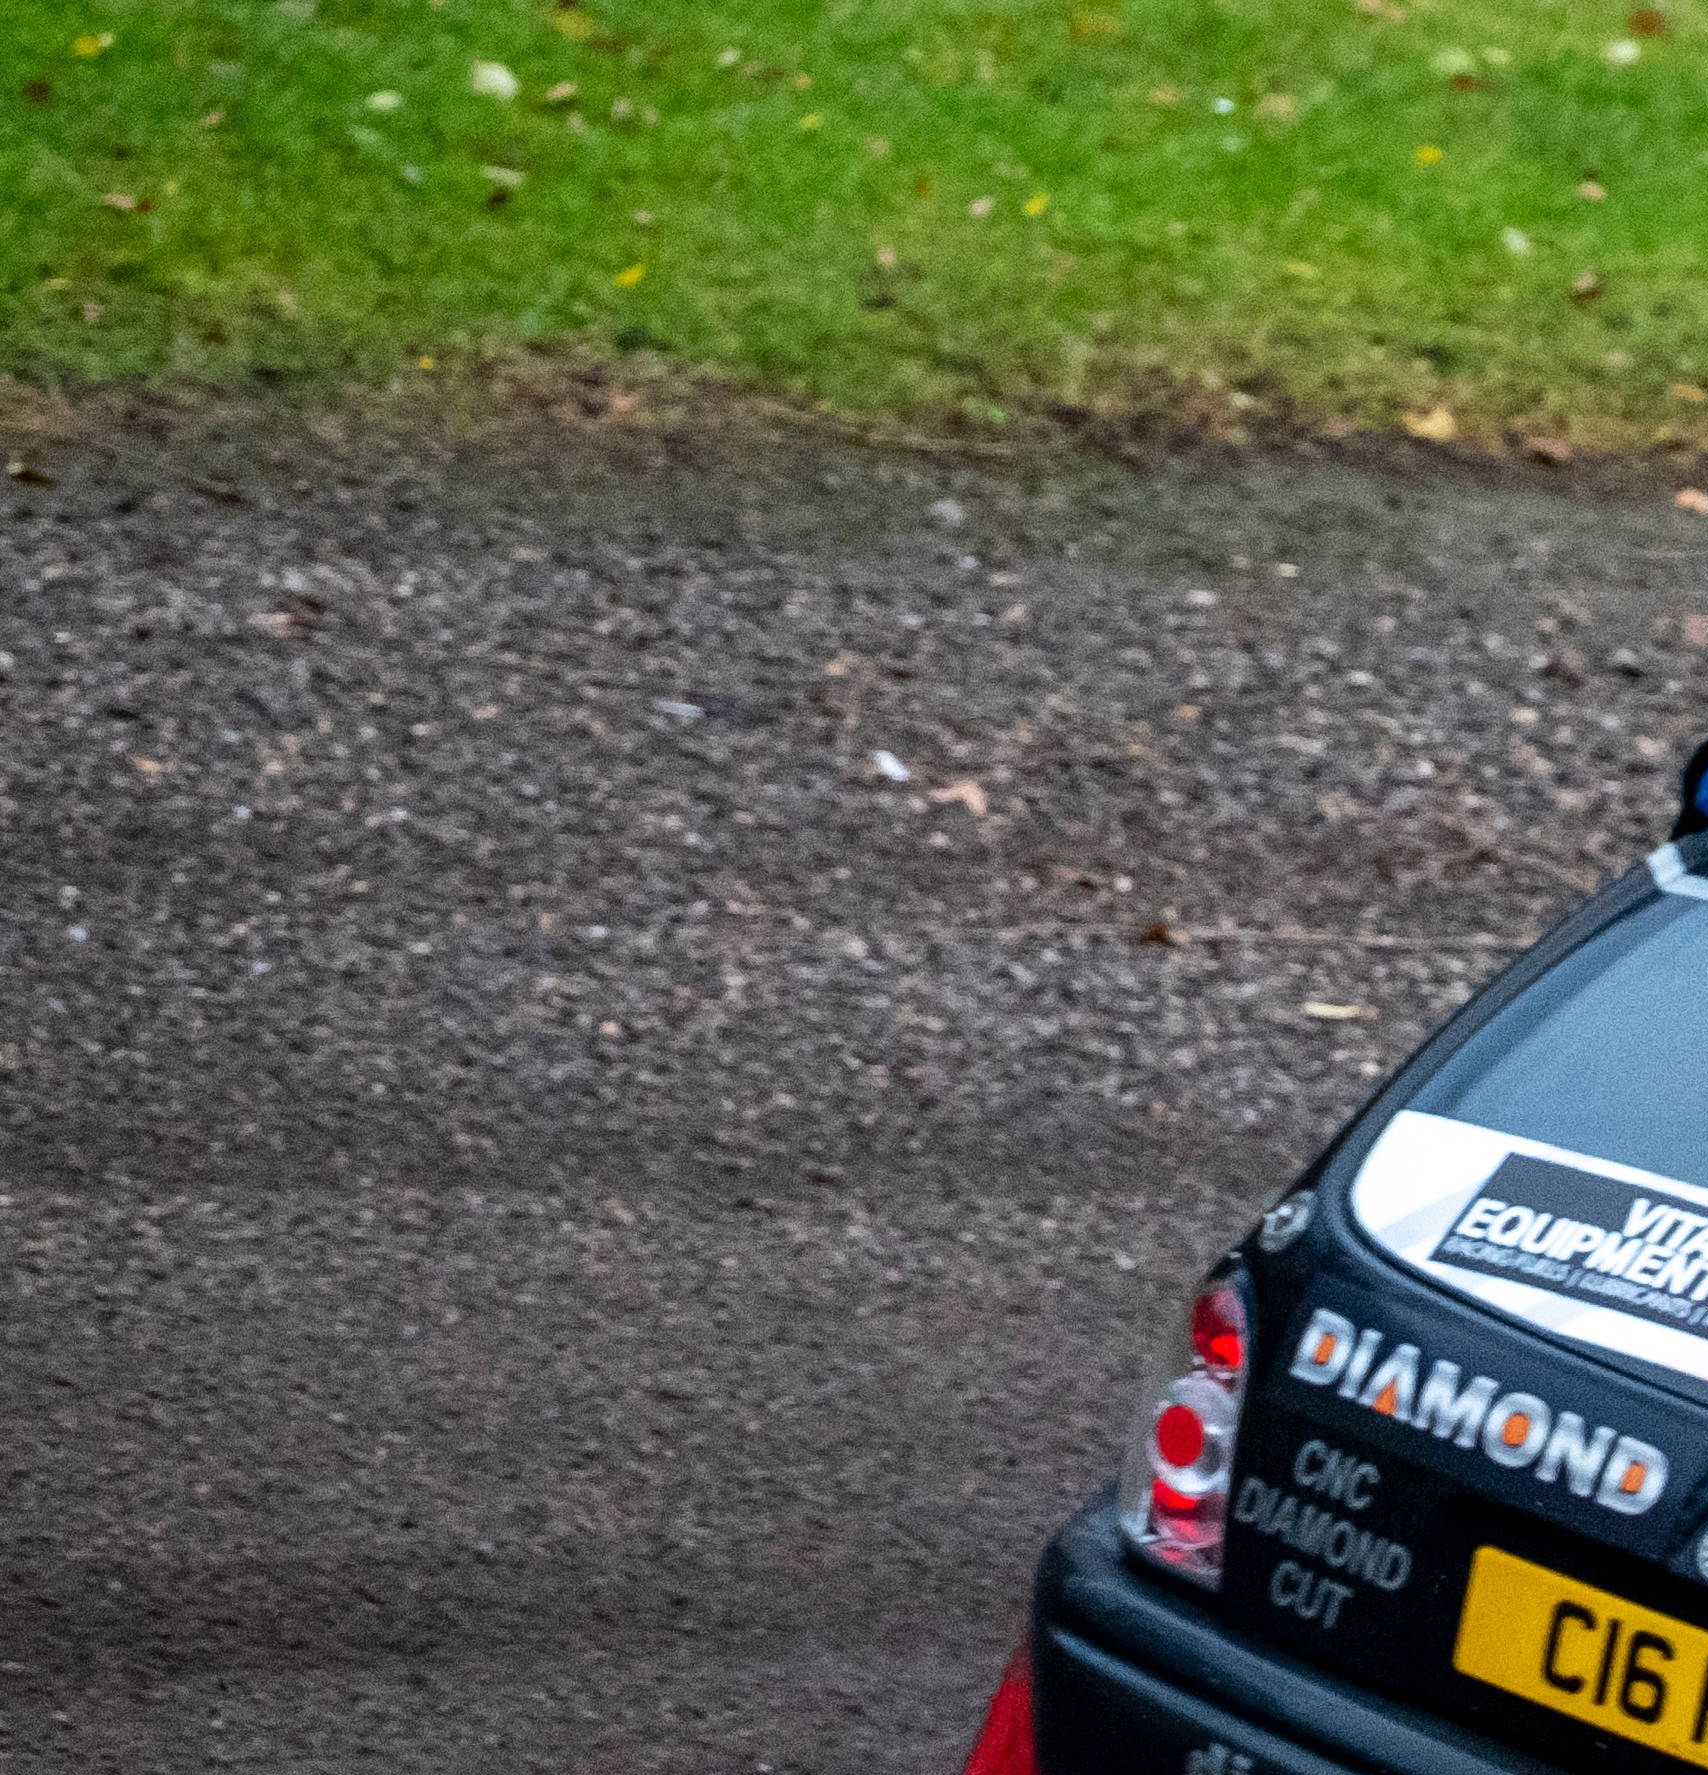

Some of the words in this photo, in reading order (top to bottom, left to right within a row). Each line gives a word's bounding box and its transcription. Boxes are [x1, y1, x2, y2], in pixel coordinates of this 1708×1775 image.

[1288, 1307, 1669, 1515] DIAMOND
[1294, 1439, 1381, 1511] CNC
[1233, 1477, 1413, 1592] DIAMOND
[1270, 1559, 1354, 1630] CUT
[1540, 1599, 1677, 1726] C16
